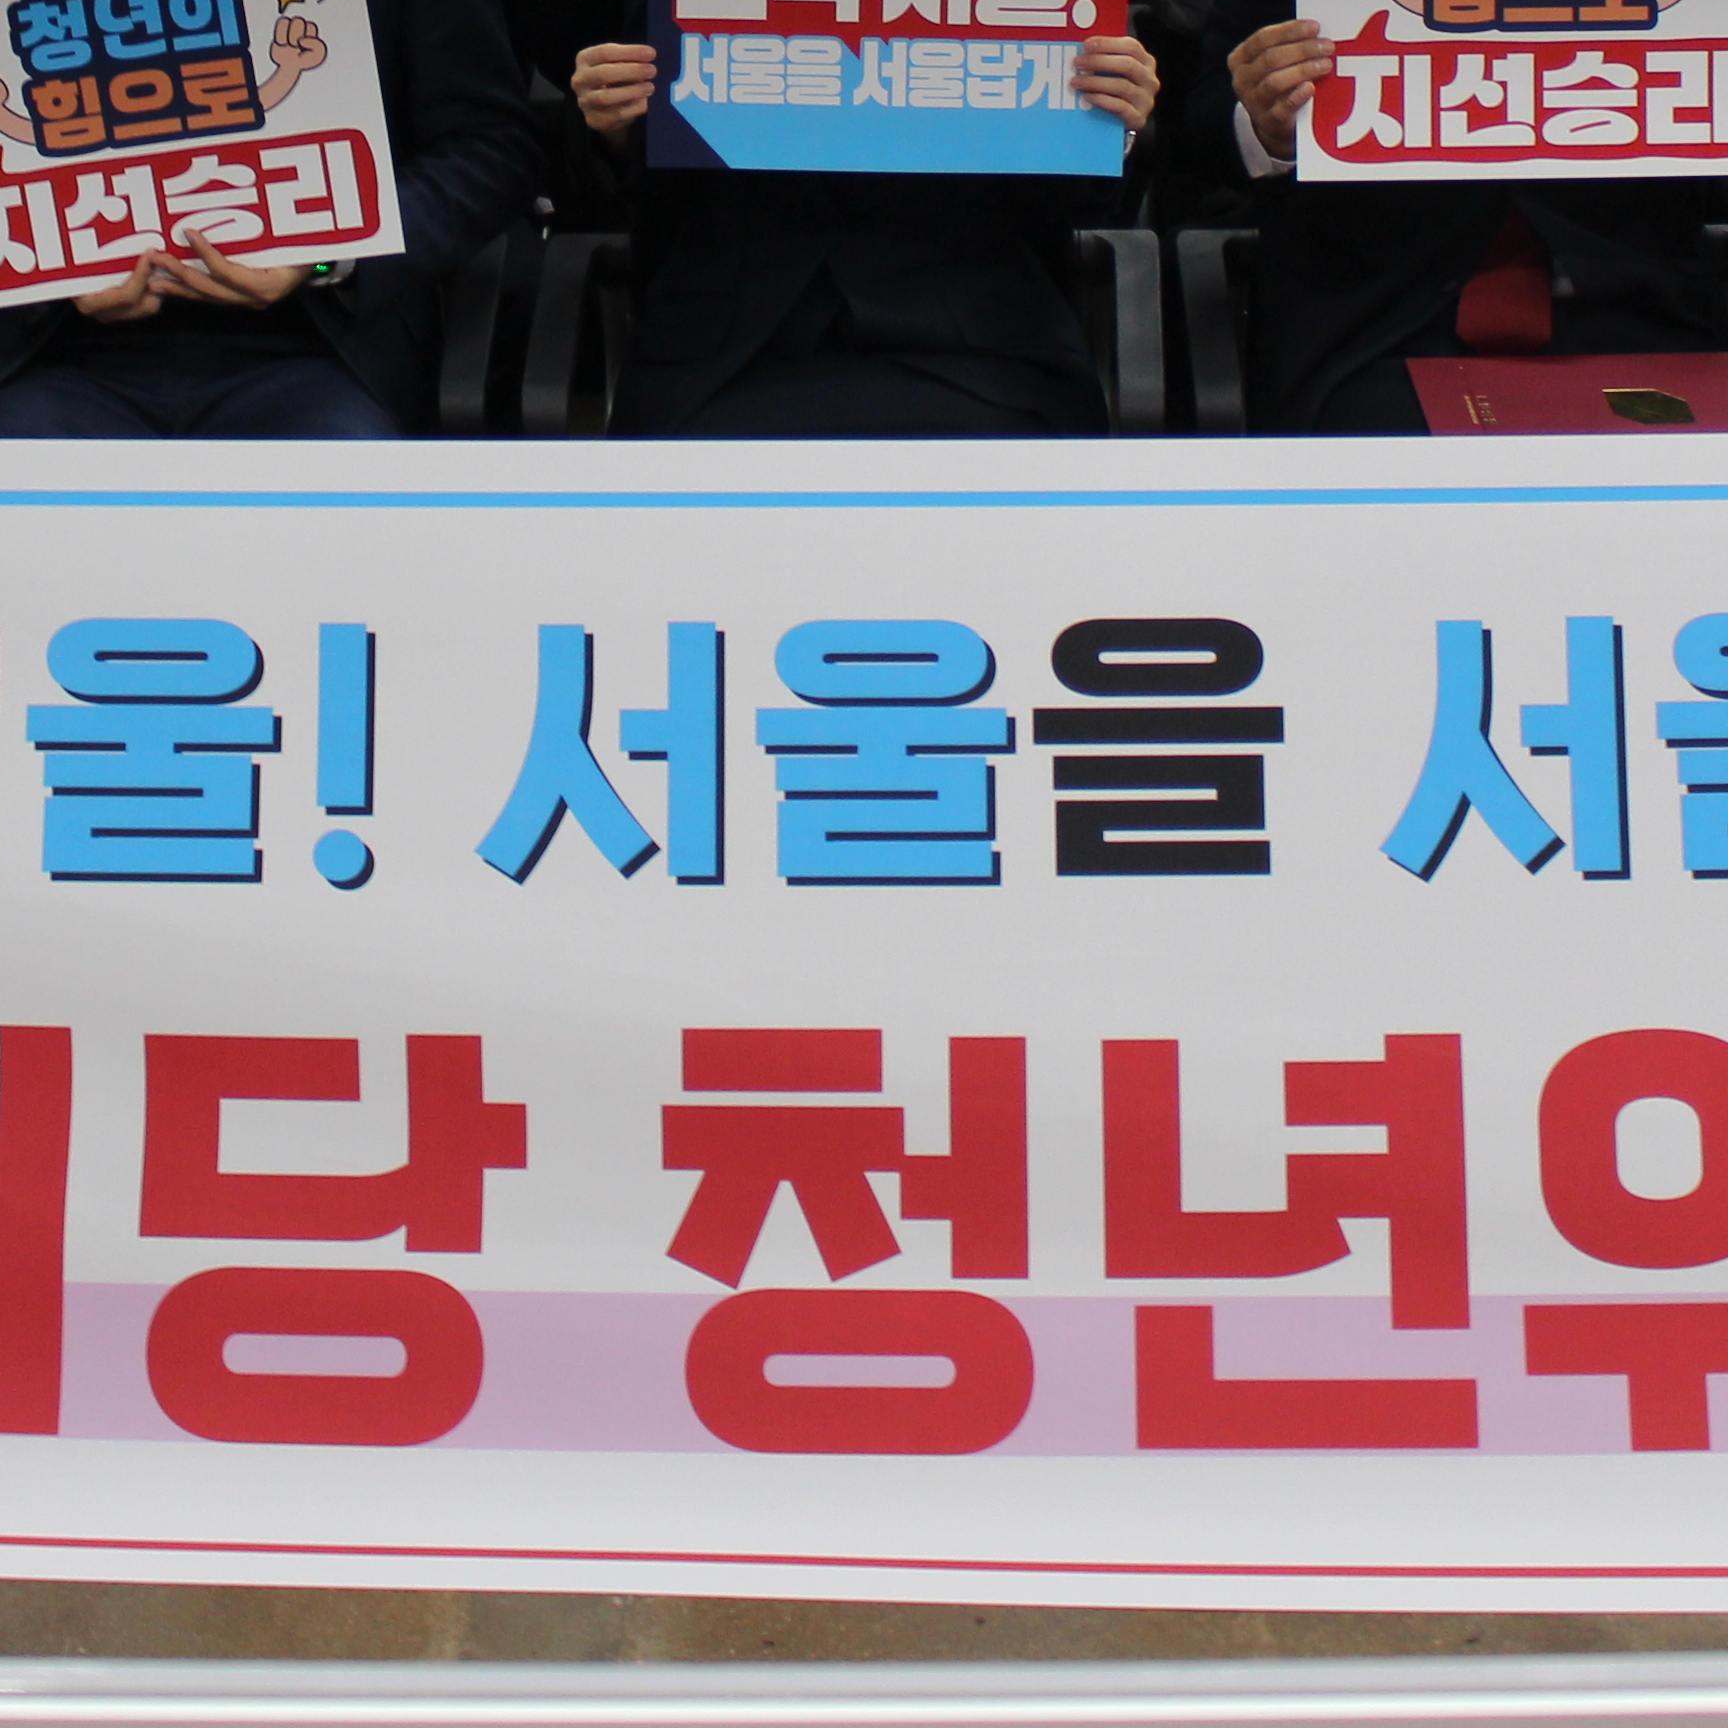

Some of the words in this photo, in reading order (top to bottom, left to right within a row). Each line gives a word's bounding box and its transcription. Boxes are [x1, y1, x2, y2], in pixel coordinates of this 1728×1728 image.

[28, 57, 257, 151] 힘으로
[673, 35, 842, 107] 서울을
[472, 616, 1286, 888] 서울을
